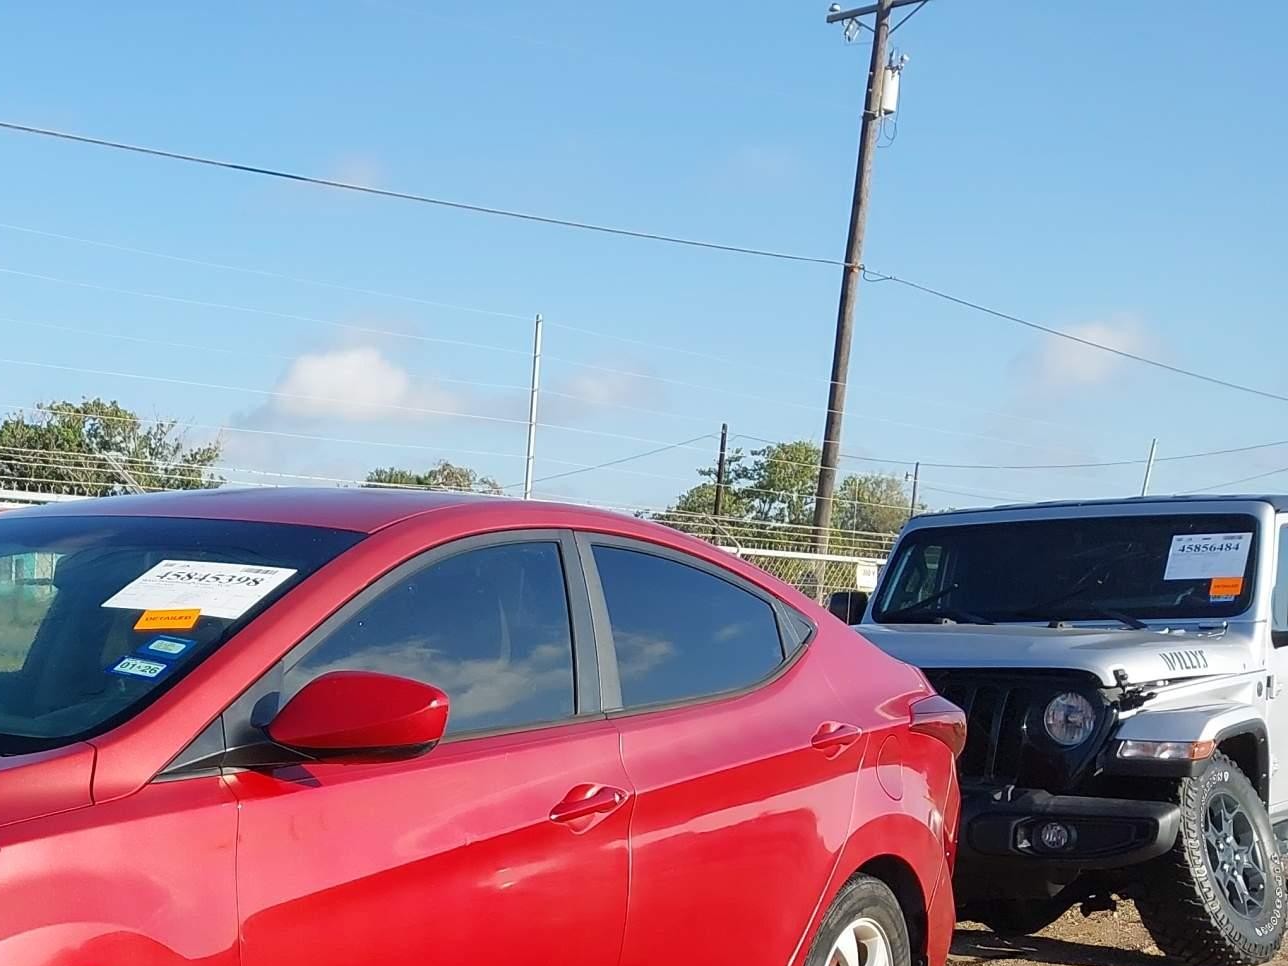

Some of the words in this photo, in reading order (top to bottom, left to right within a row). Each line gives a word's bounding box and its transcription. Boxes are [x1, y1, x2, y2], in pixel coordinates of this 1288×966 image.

[1178, 543, 1241, 553] 45856484
[156, 571, 265, 587] 45845398
[1159, 650, 1208, 671] WILLYS
